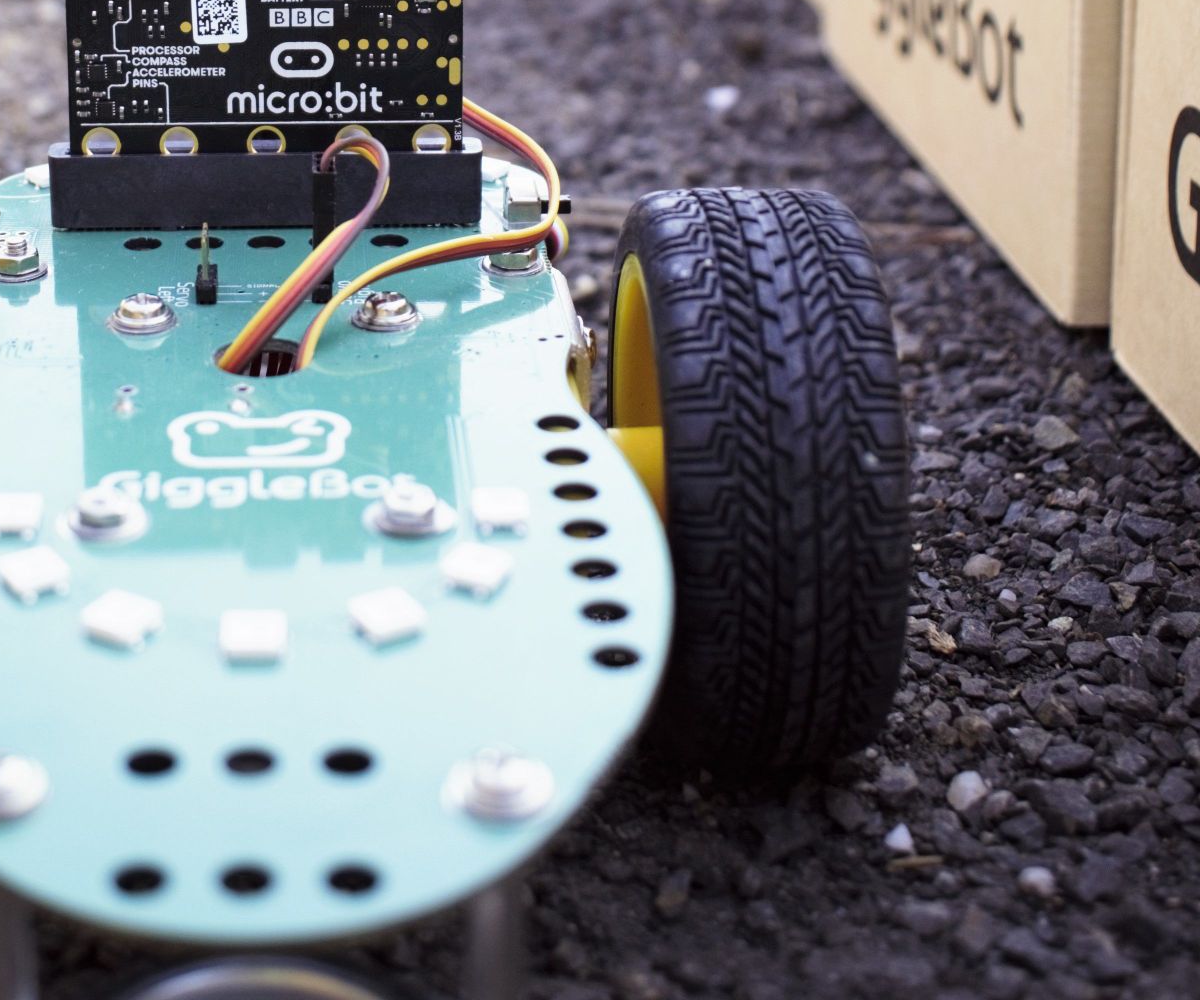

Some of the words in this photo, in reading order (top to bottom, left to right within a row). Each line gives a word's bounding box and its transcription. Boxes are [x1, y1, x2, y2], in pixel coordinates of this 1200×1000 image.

[271, 9, 332, 26] BBC
[131, 45, 200, 55] PROCESSOR
[132, 56, 188, 66] COMPASS
[132, 67, 226, 77] ACCELEROMETER
[132, 78, 158, 88] PINS
[226, 81, 383, 114] micro:bit
[175, 282, 195, 307] Servo
